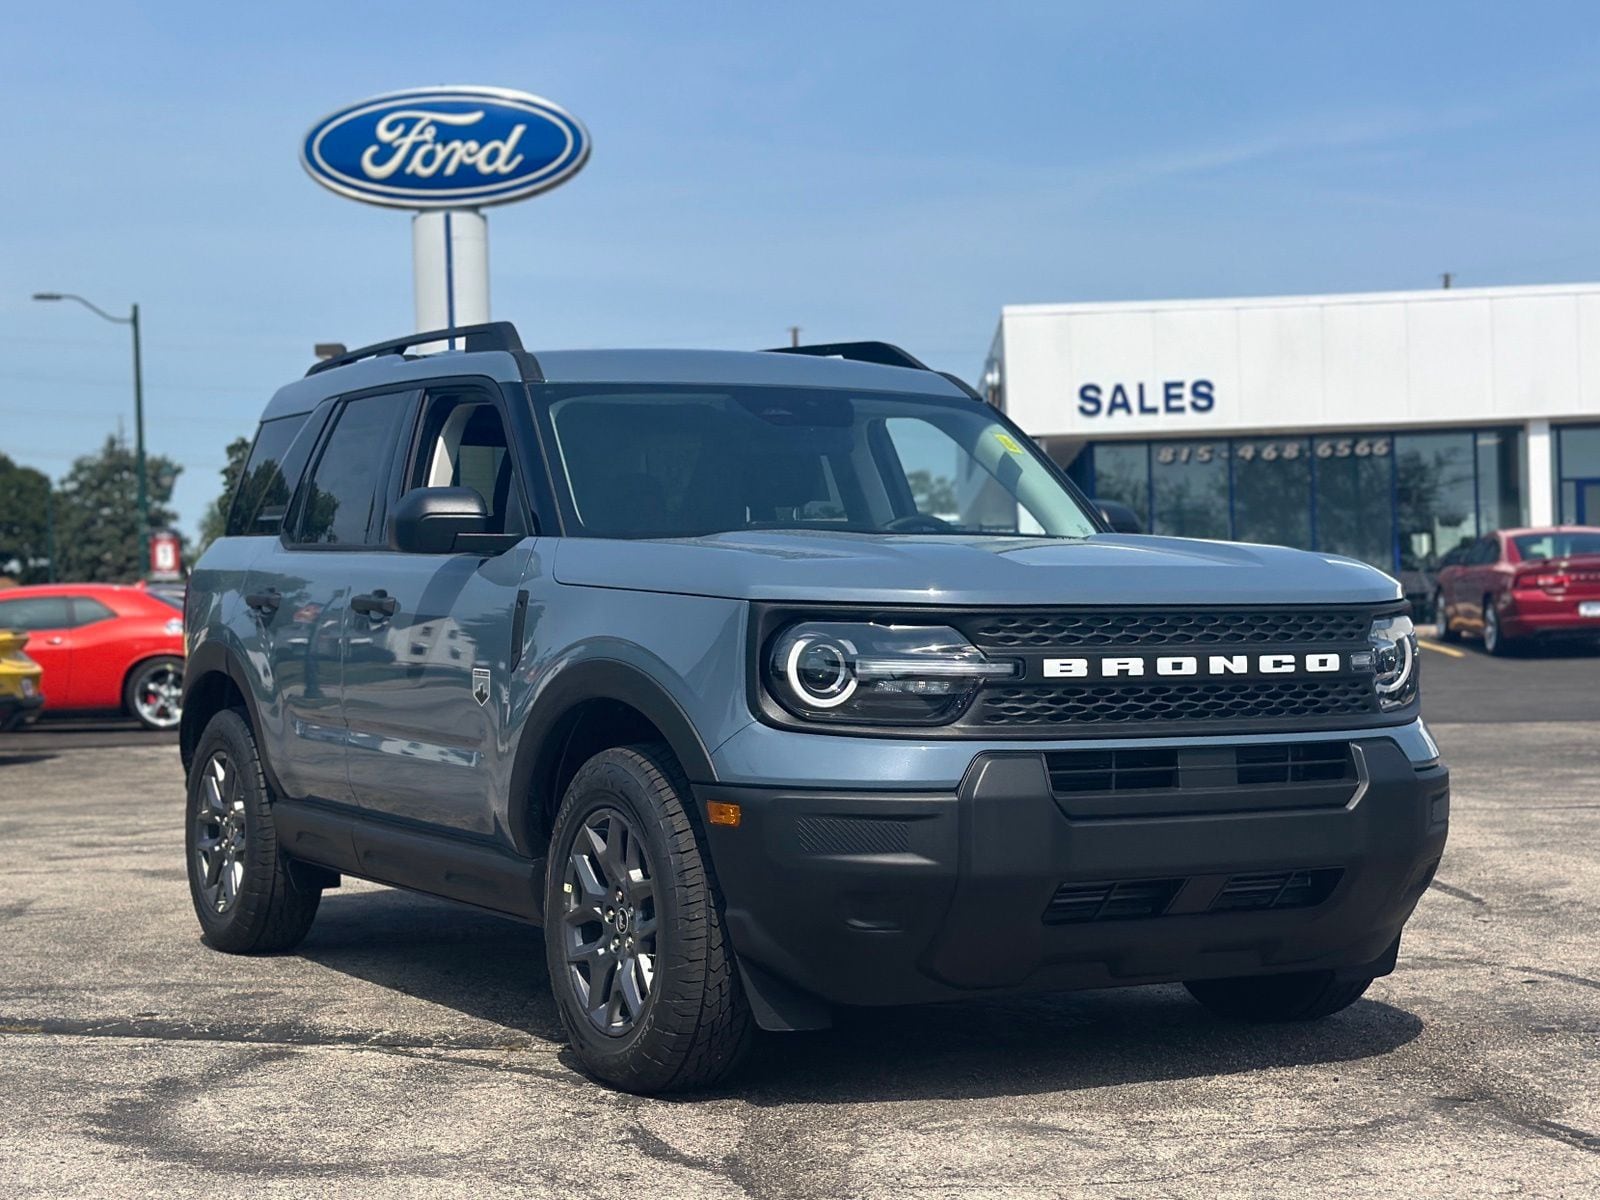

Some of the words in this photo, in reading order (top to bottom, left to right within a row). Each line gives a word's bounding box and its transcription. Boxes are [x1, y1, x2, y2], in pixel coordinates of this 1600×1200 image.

[361, 110, 527, 179] Ford
[1077, 379, 1216, 417] SALES
[1043, 653, 1340, 678] BRONCO
